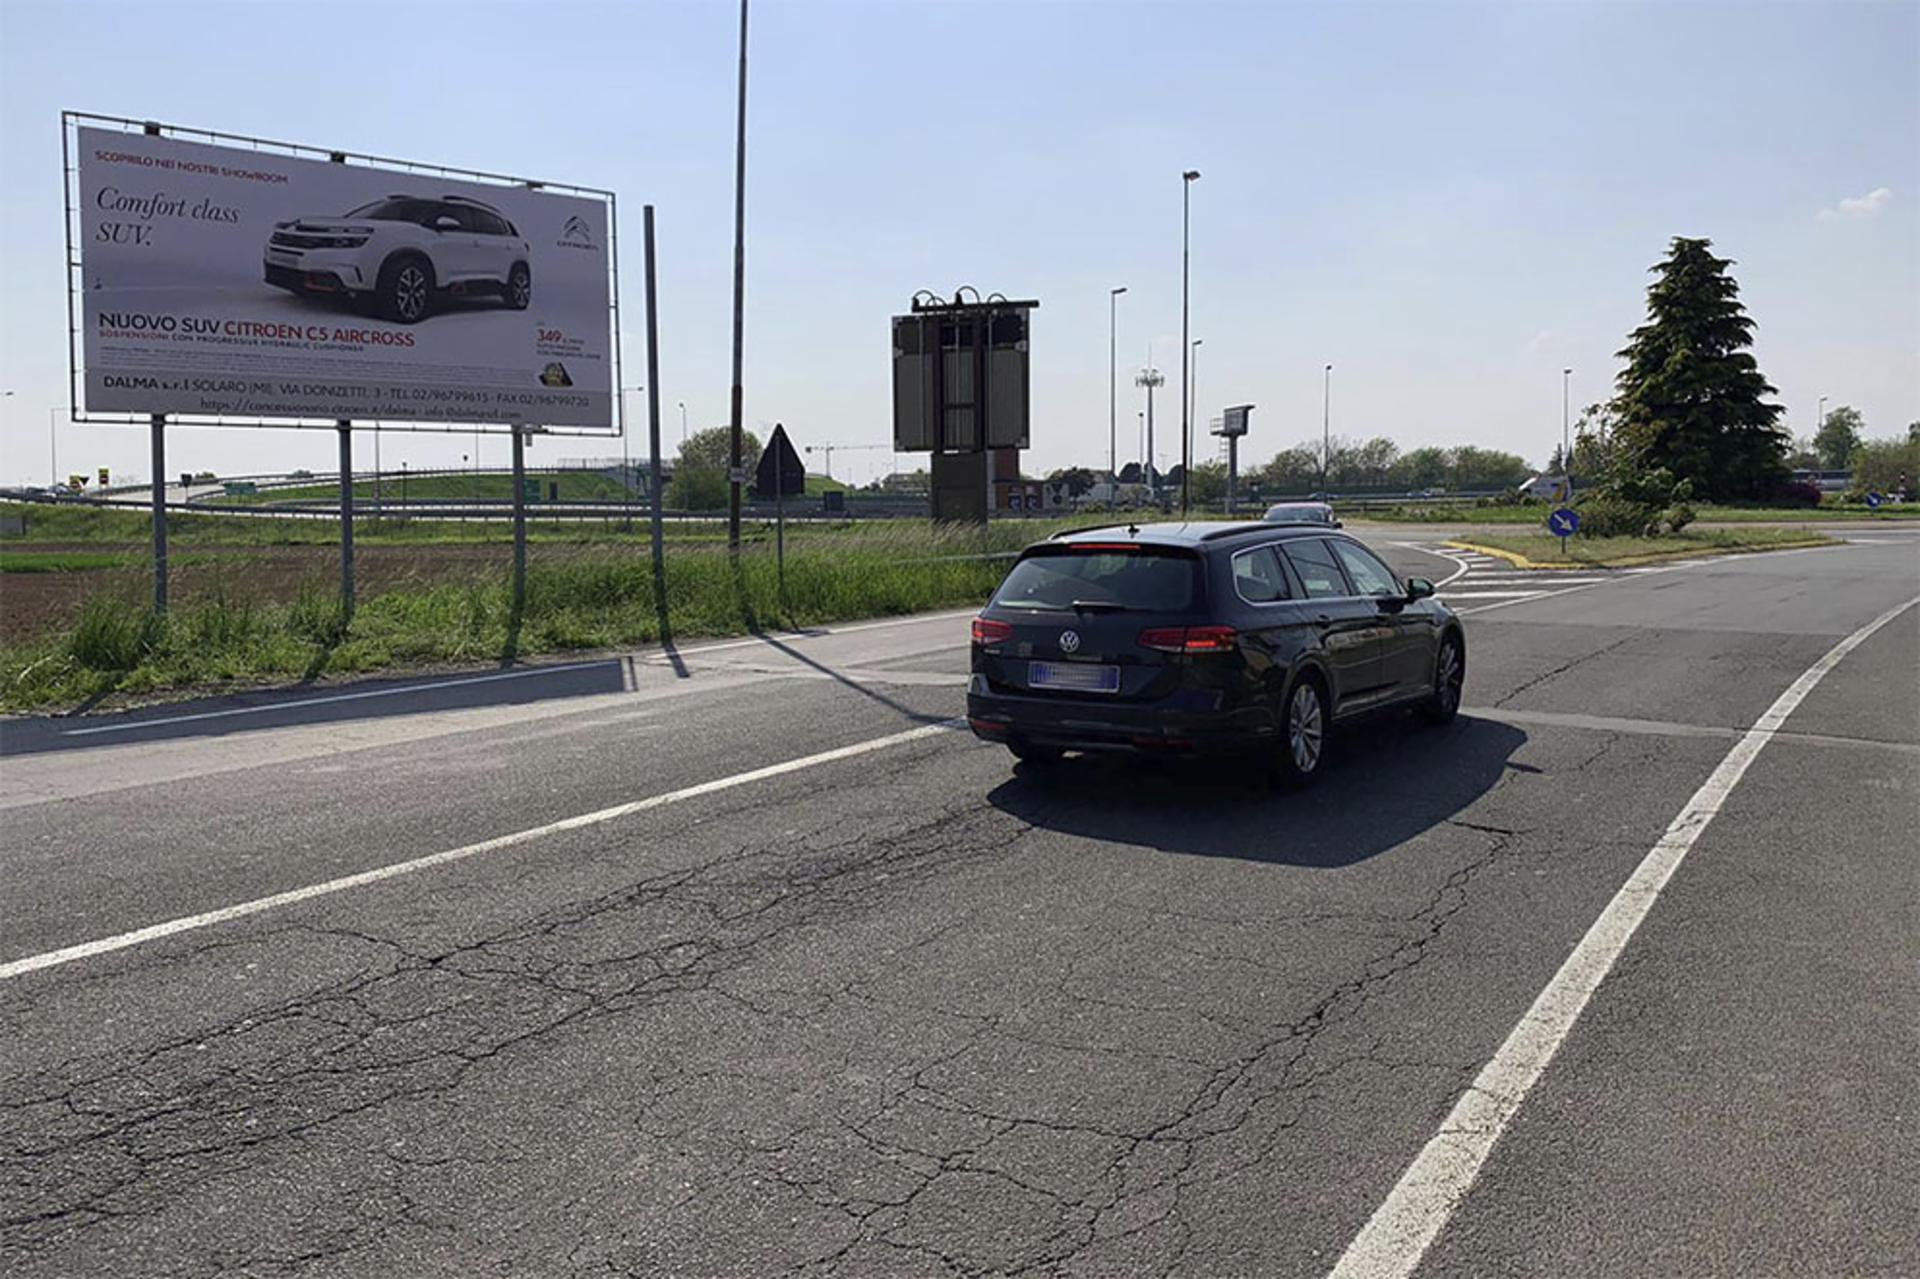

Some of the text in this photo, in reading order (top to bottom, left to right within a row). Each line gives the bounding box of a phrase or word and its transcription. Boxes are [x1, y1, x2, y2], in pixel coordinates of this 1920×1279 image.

[95, 151, 288, 184] SCOPRILO NEI NOSTRI SHOWROOM
[96, 187, 241, 223] Comfort class
[96, 221, 152, 246] SUV.
[99, 312, 415, 347] NUOVO SUV CITROEN C5 AIRCROSS
[99, 330, 169, 341] SOSPENSIONI
[171, 333, 193, 342] CON
[197, 335, 258, 346] PROGRESSIVE
[537, 328, 562, 342] 349
[104, 375, 158, 389] DALMA
[192, 378, 247, 393] SOLARO
[279, 383, 301, 395] VIA
